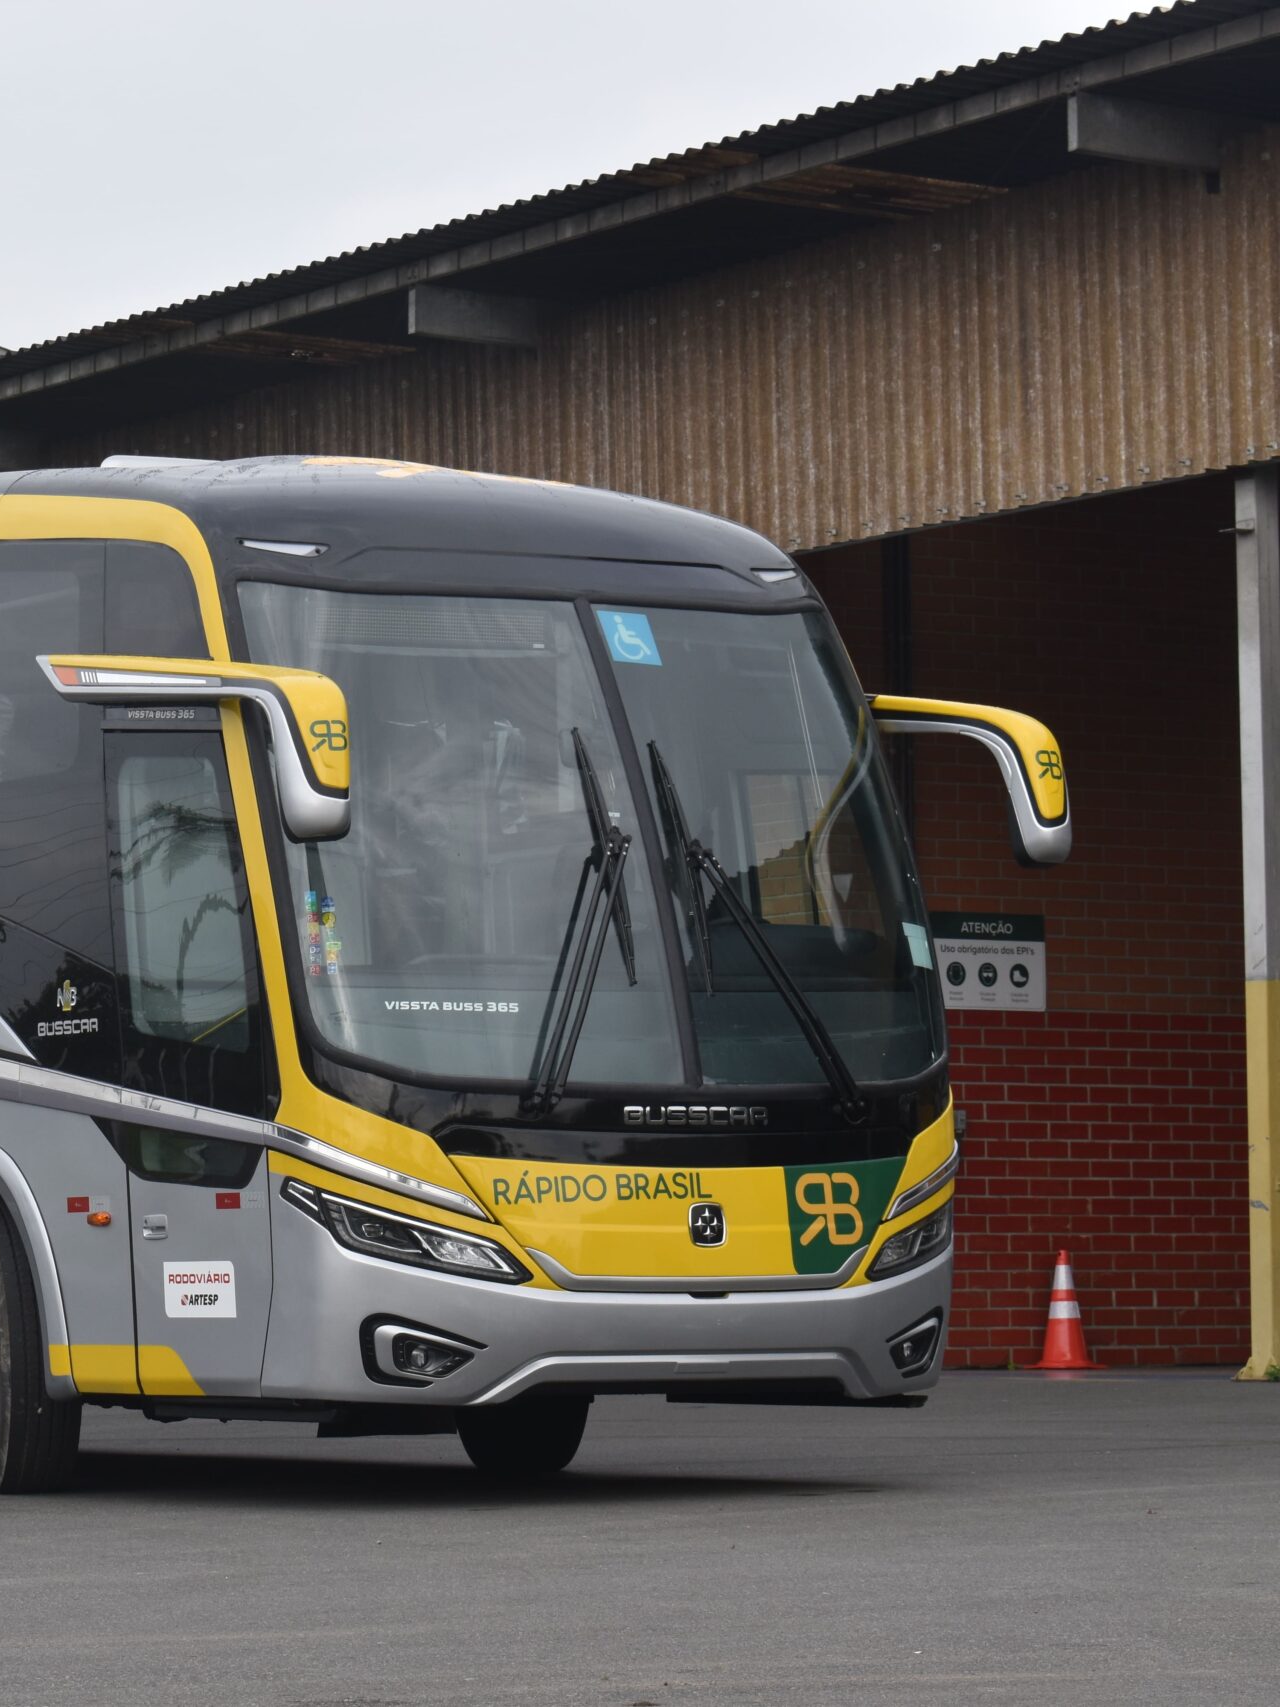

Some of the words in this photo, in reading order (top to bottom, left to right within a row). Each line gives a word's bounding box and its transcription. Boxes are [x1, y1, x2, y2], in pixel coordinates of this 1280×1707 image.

[128, 710, 154, 719] VISSTA
[155, 710, 177, 719] BUSS
[177, 709, 195, 719] 365
[960, 920, 1014, 936] ATENÇÃO
[957, 944, 999, 956] obrigatório
[384, 1001, 440, 1010] VISSTA
[442, 1001, 484, 1012] BUSS
[486, 1001, 519, 1013] 365
[37, 1018, 99, 1037] BUSSCAR
[623, 1105, 768, 1126] BUSSCAR
[493, 1171, 607, 1205] RÁPIDO
[616, 1172, 713, 1201] BRASIL
[168, 1269, 231, 1285] RODOVIÁRIO
[188, 1294, 219, 1306] ARTESP
